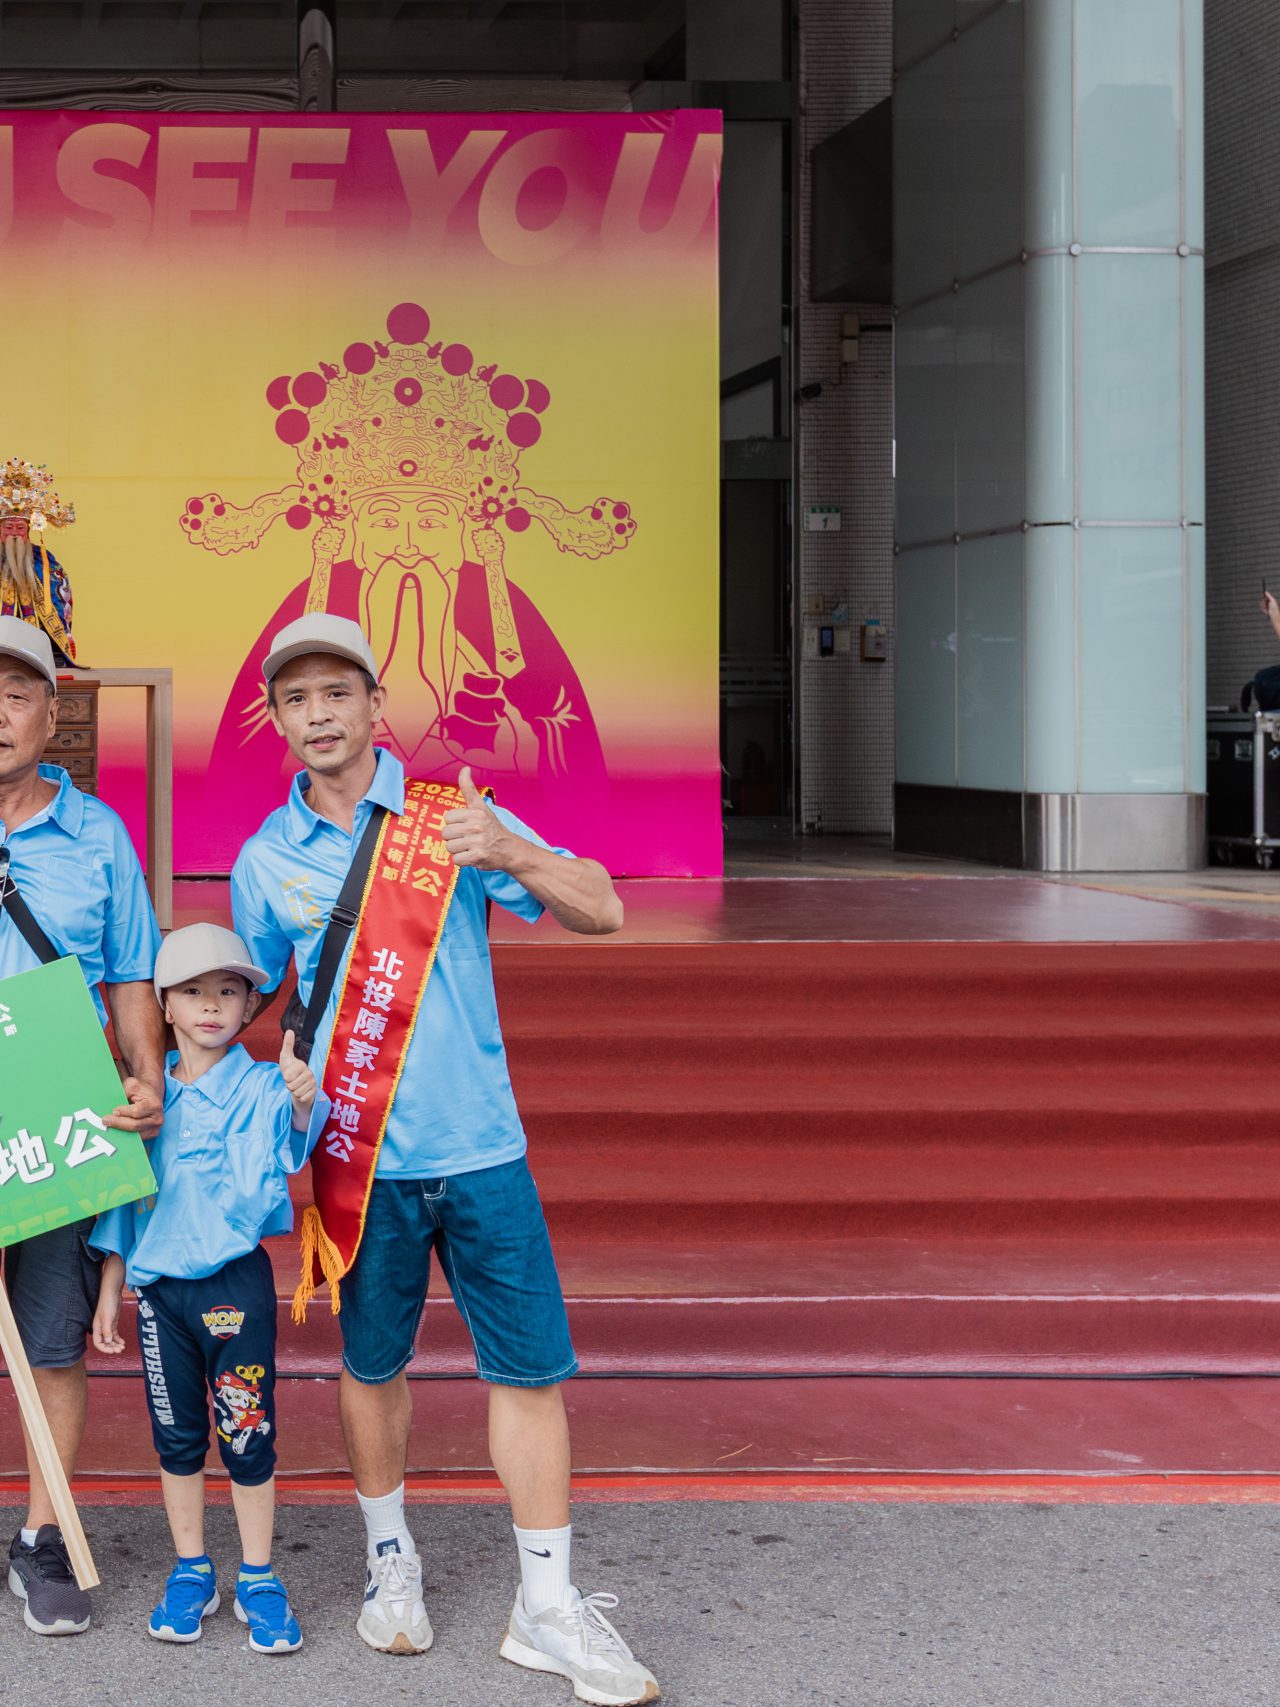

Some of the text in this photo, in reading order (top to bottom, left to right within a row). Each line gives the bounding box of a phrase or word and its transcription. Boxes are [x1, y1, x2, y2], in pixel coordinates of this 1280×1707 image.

[56, 123, 351, 260] SEE
[387, 128, 722, 266] YOU
[400, 804, 429, 884] FOLK ARTS FESTIVAL
[325, 947, 404, 1163] 北投陳家土地公
[202, 1312, 244, 1327] WOW
[141, 1321, 175, 1426] MARSHALL
